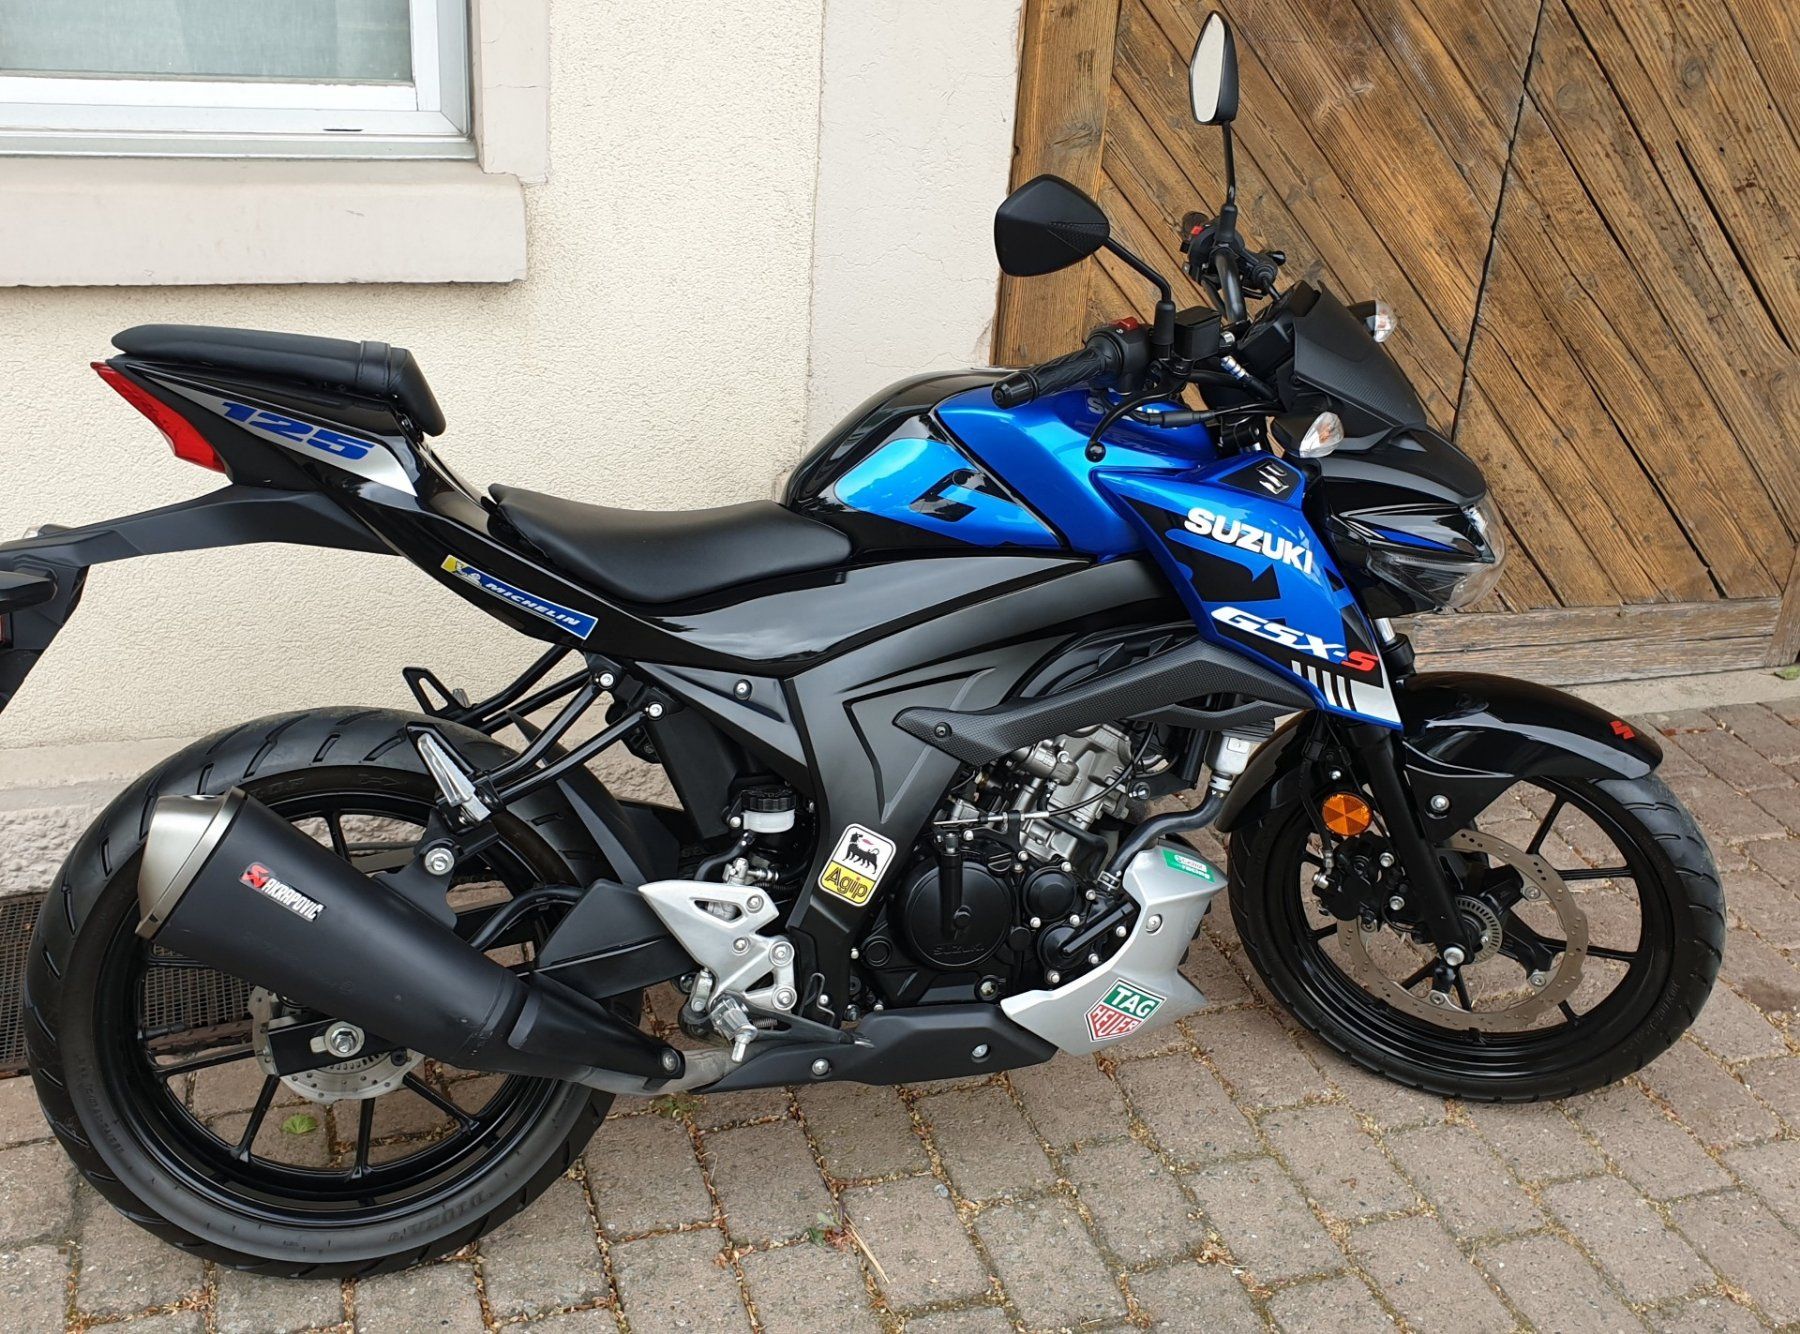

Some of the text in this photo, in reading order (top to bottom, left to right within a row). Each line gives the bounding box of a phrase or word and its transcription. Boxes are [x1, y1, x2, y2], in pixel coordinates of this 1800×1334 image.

[222, 402, 375, 460] 125
[1184, 507, 1314, 574] SUZUKI
[485, 582, 581, 626] MICHELIN
[1211, 606, 1379, 672] GSX-S
[825, 867, 868, 899] Agip
[1091, 1005, 1140, 1037] HEUER
[1111, 986, 1156, 1017] TAG
